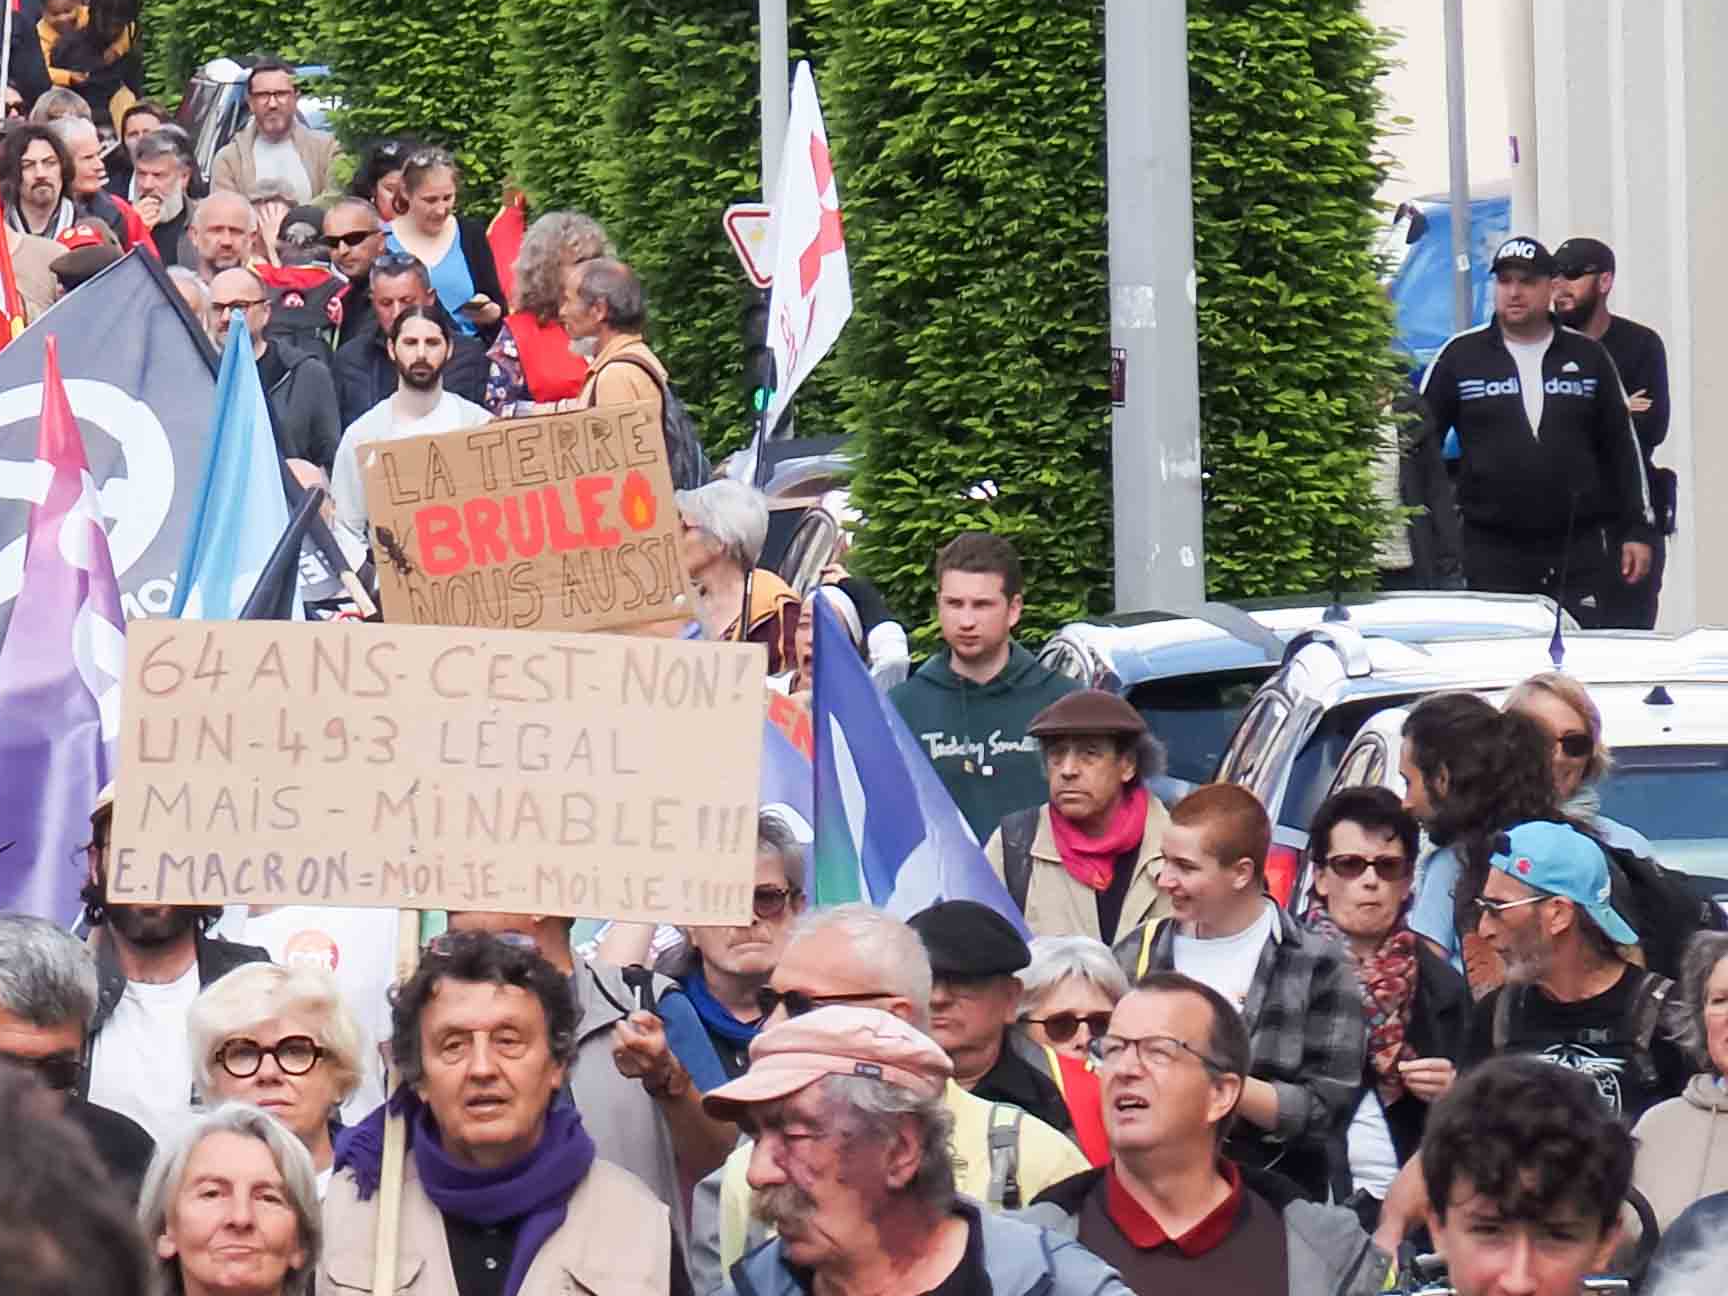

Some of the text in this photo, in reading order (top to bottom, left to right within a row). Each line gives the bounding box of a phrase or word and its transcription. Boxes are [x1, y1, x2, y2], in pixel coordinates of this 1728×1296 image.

[382, 411, 657, 505] LA TERRE
[415, 475, 622, 576] BRULE
[407, 561, 544, 629] NOUS
[561, 534, 688, 618] AUSSI
